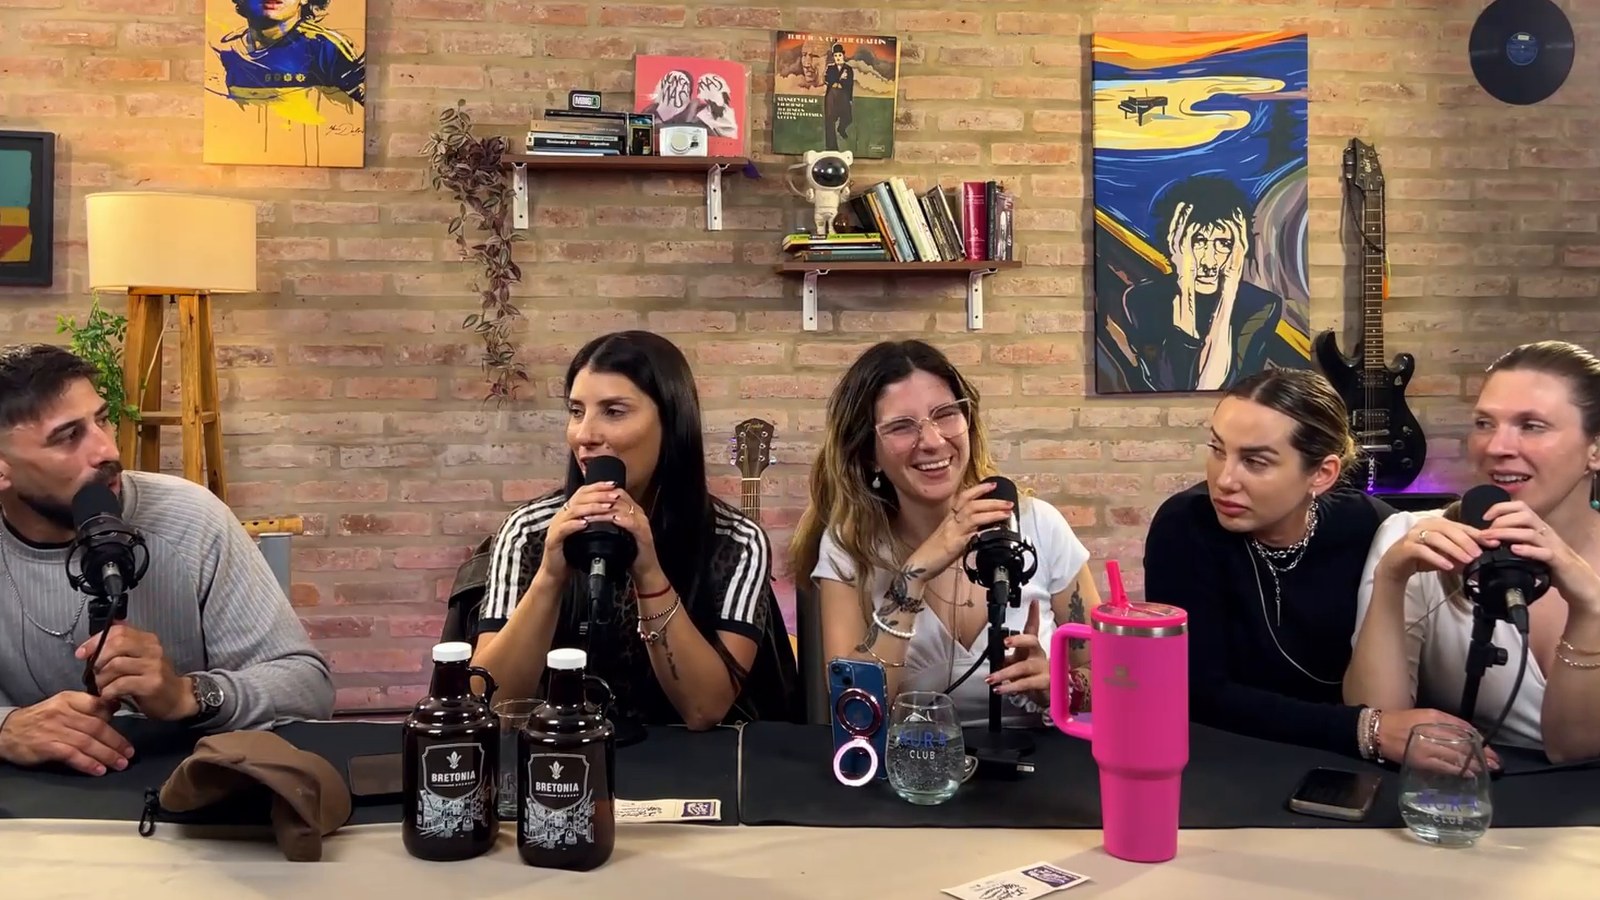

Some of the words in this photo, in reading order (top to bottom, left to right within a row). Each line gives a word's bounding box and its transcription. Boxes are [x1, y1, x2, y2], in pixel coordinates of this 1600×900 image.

[909, 750, 936, 760] CLUB
[431, 769, 476, 783] BRETONIA
[535, 781, 579, 793] BRETONIA
[1432, 813, 1465, 825] CLUB
